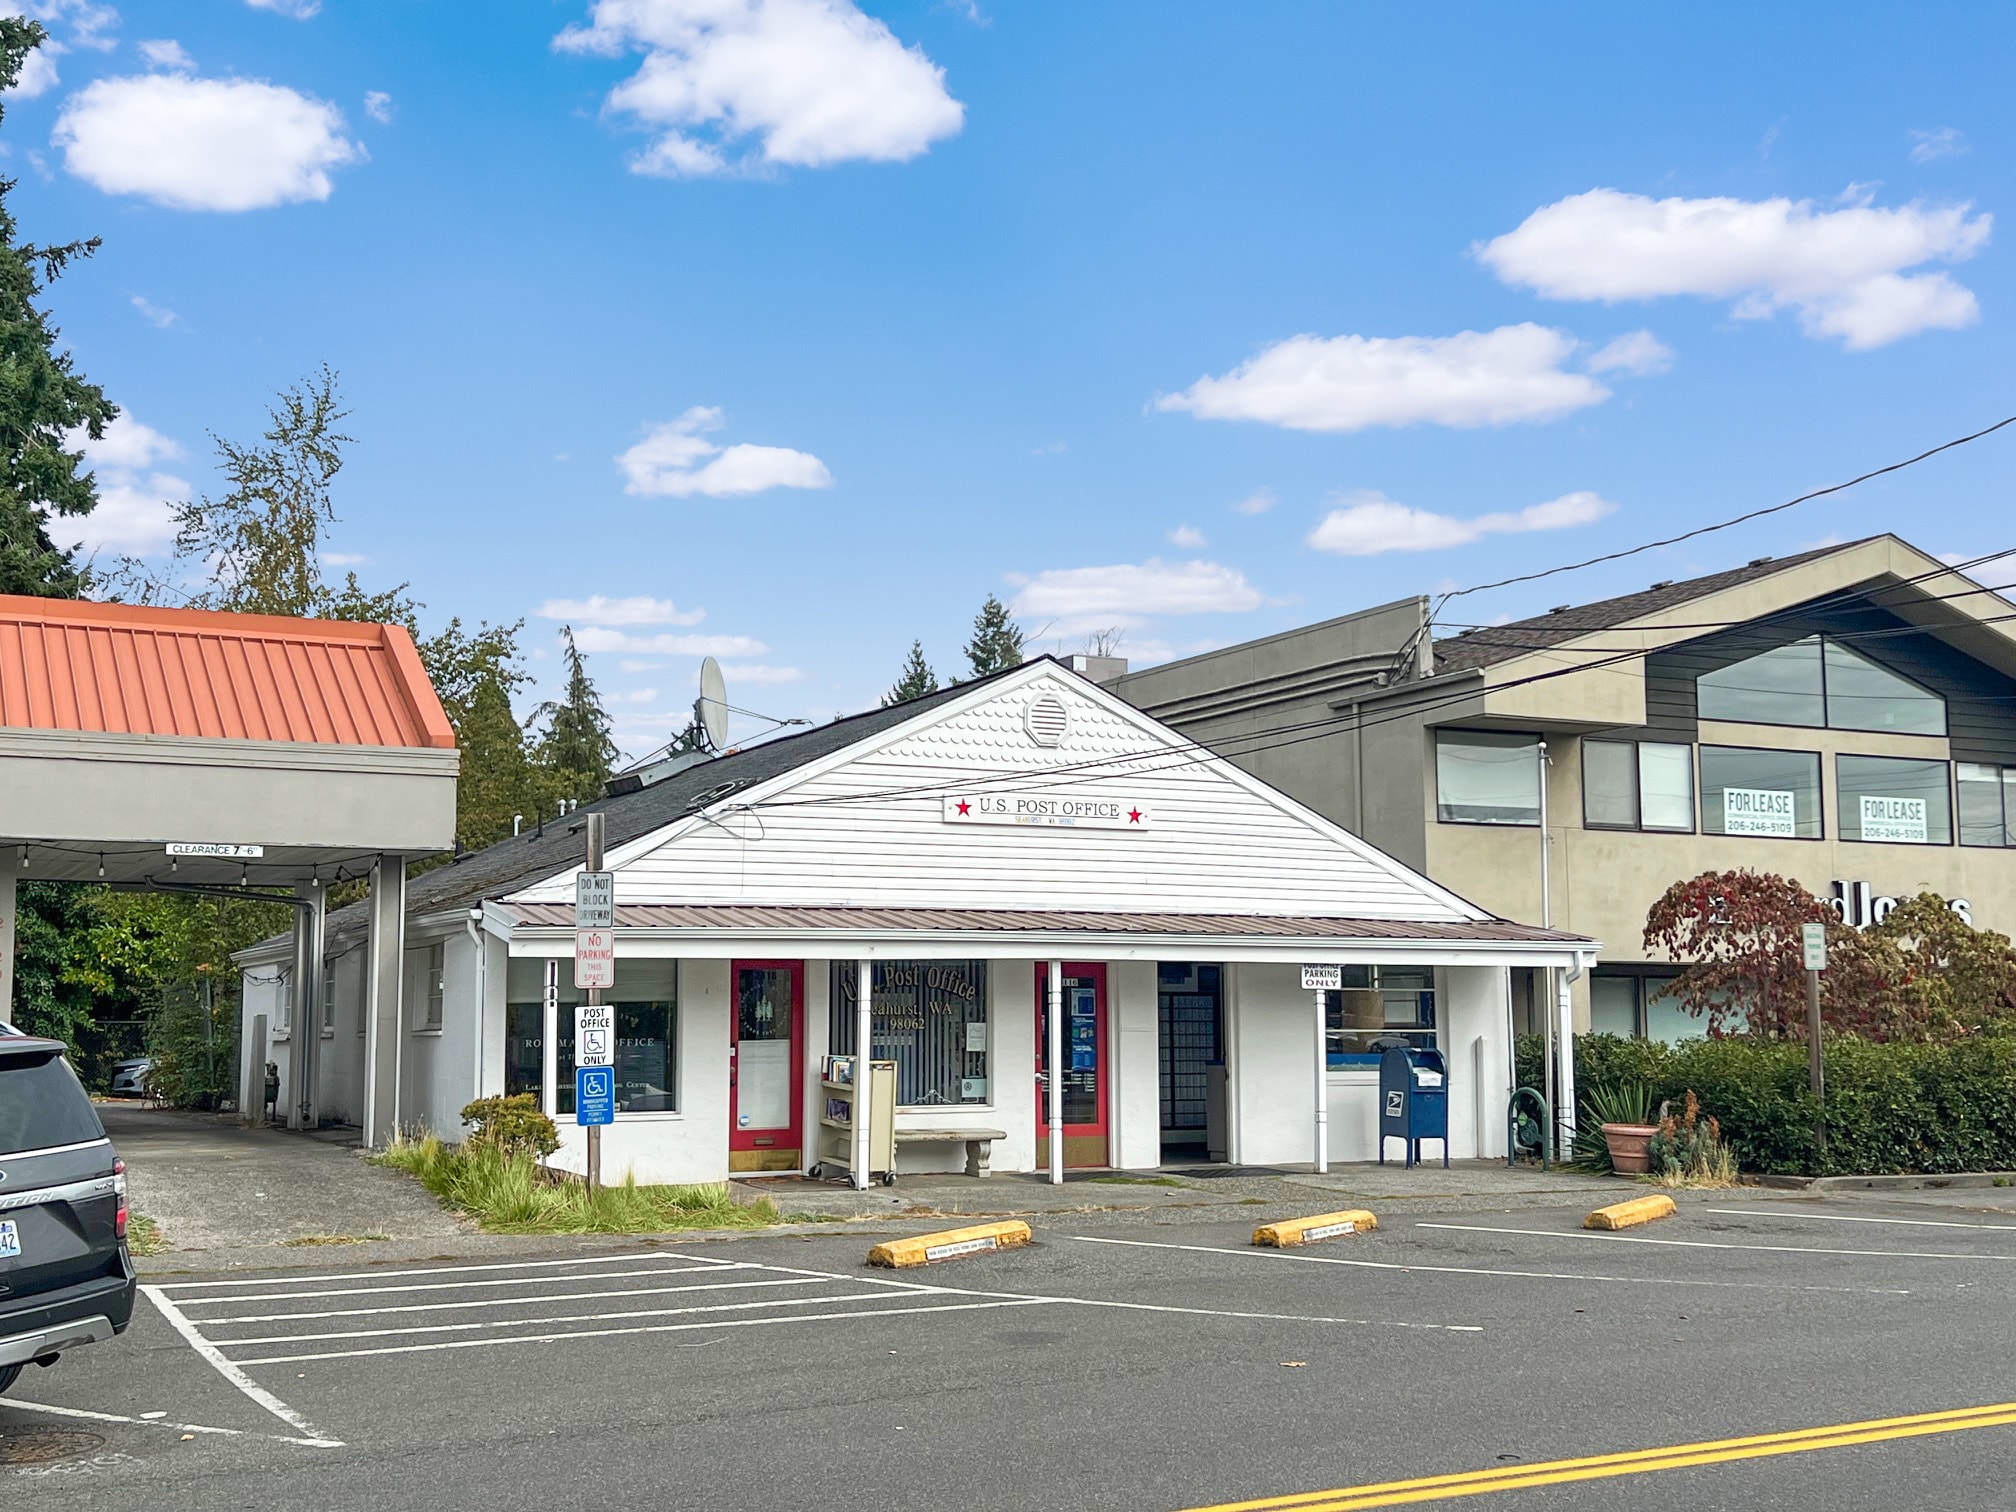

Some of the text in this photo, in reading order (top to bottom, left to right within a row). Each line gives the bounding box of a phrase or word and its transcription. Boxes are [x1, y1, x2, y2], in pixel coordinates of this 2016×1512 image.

[979, 798, 1120, 817] U.S. POST OFFICE
[1728, 820, 1792, 832] 206-246-5109
[1864, 827, 1924, 839] 206-246-5109
[172, 845, 231, 855] CLEARANCE
[581, 878, 609, 890] DO NOT
[582, 894, 608, 905] BLOCK
[579, 909, 610, 920] DRIVEWAY
[588, 935, 602, 946] NO
[578, 949, 611, 960] PARKING
[583, 973, 605, 982] SPACE
[1304, 969, 1339, 978] PARKING
[884, 963, 919, 987] Post
[927, 966, 976, 1000] Office
[584, 1008, 605, 1018] POST
[870, 1001, 952, 1017] eahurst, WA
[580, 1018, 610, 1028] OFFICE
[890, 1018, 925, 1030] 98062
[615, 1037, 655, 1047] FFICE
[583, 1055, 607, 1065] ONLY
